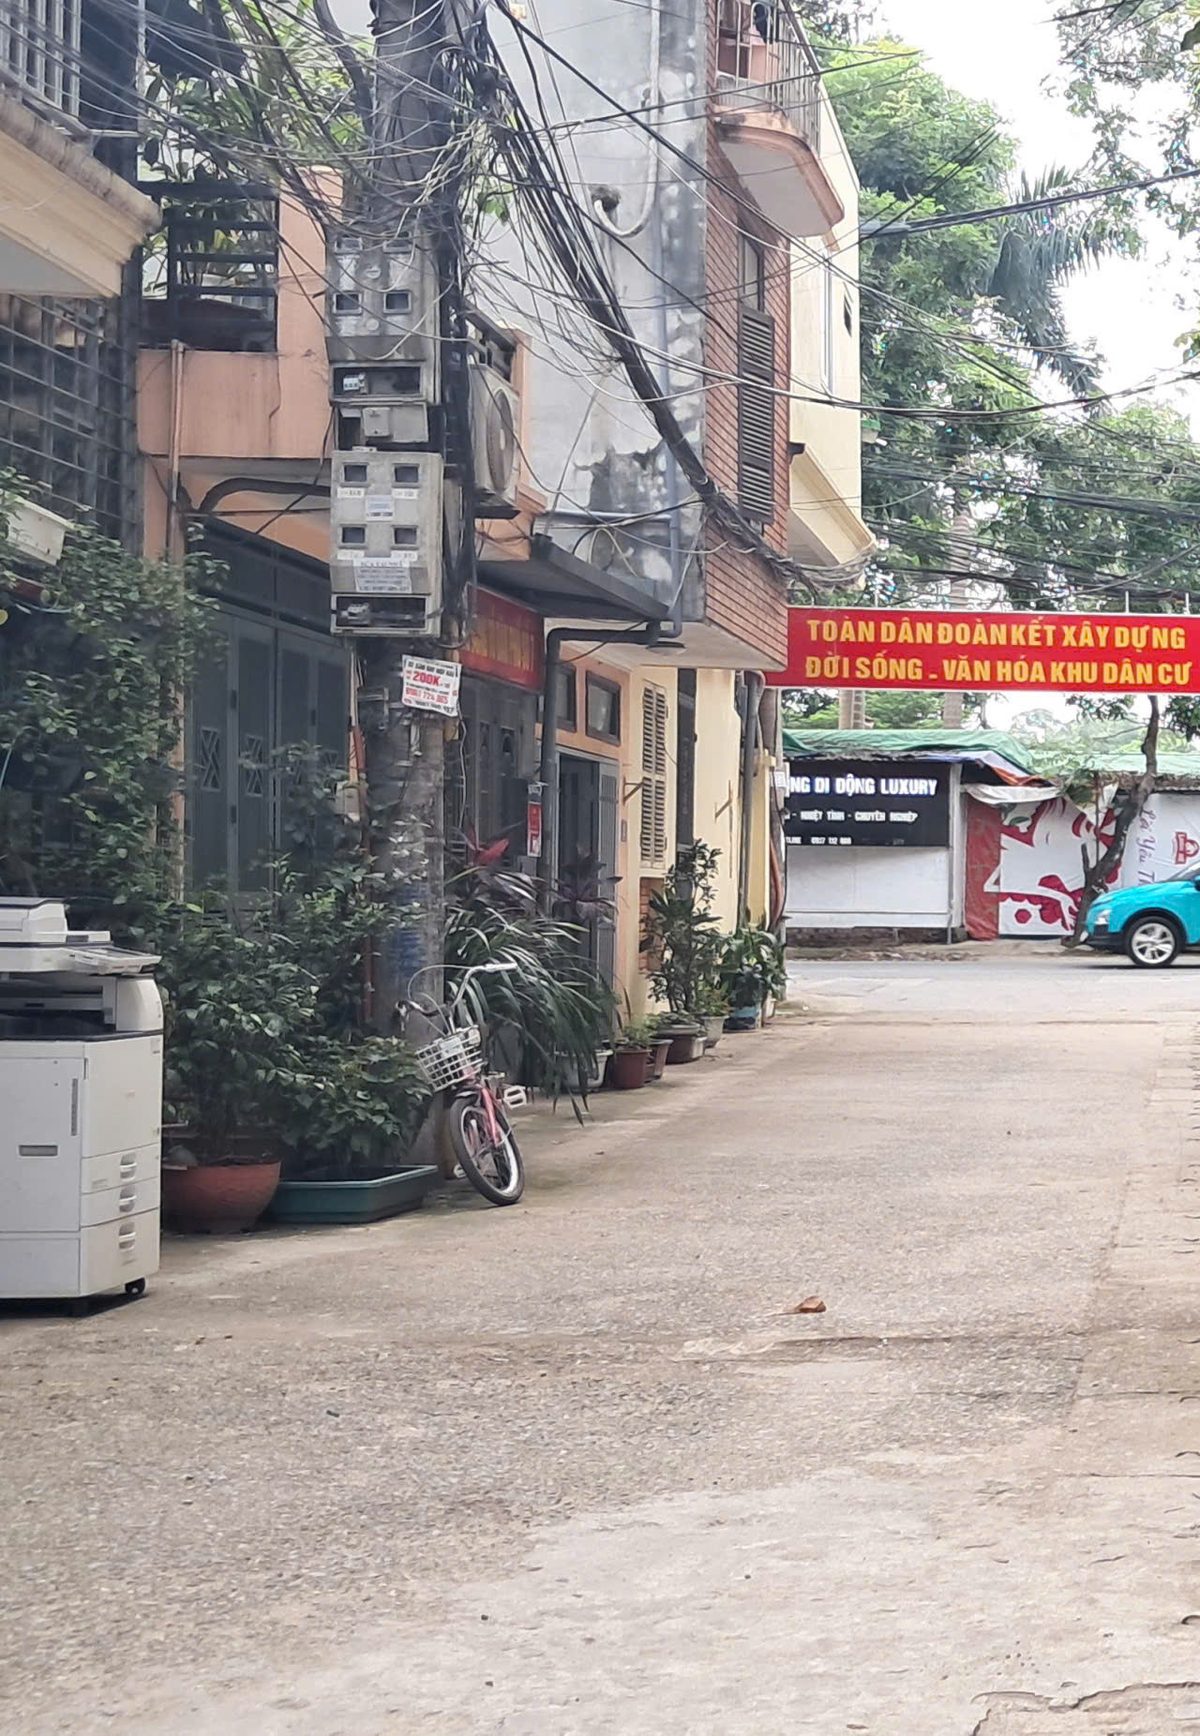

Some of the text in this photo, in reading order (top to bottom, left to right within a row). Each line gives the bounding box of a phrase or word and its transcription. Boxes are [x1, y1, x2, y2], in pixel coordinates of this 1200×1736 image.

[807, 616, 1186, 653] TOÀN DÂN ĐOÀN KẾT XÂY DỰNG
[805, 651, 850, 679] ĐỜI
[855, 650, 924, 680] SỐNG
[942, 655, 991, 682] VĂN
[997, 655, 1046, 682] HÓA
[1051, 662, 1098, 684] KHU
[1103, 658, 1153, 684] DÂN
[1158, 662, 1193, 685] CƯ
[790, 776, 811, 793] NG
[880, 777, 938, 796] LUXURY
